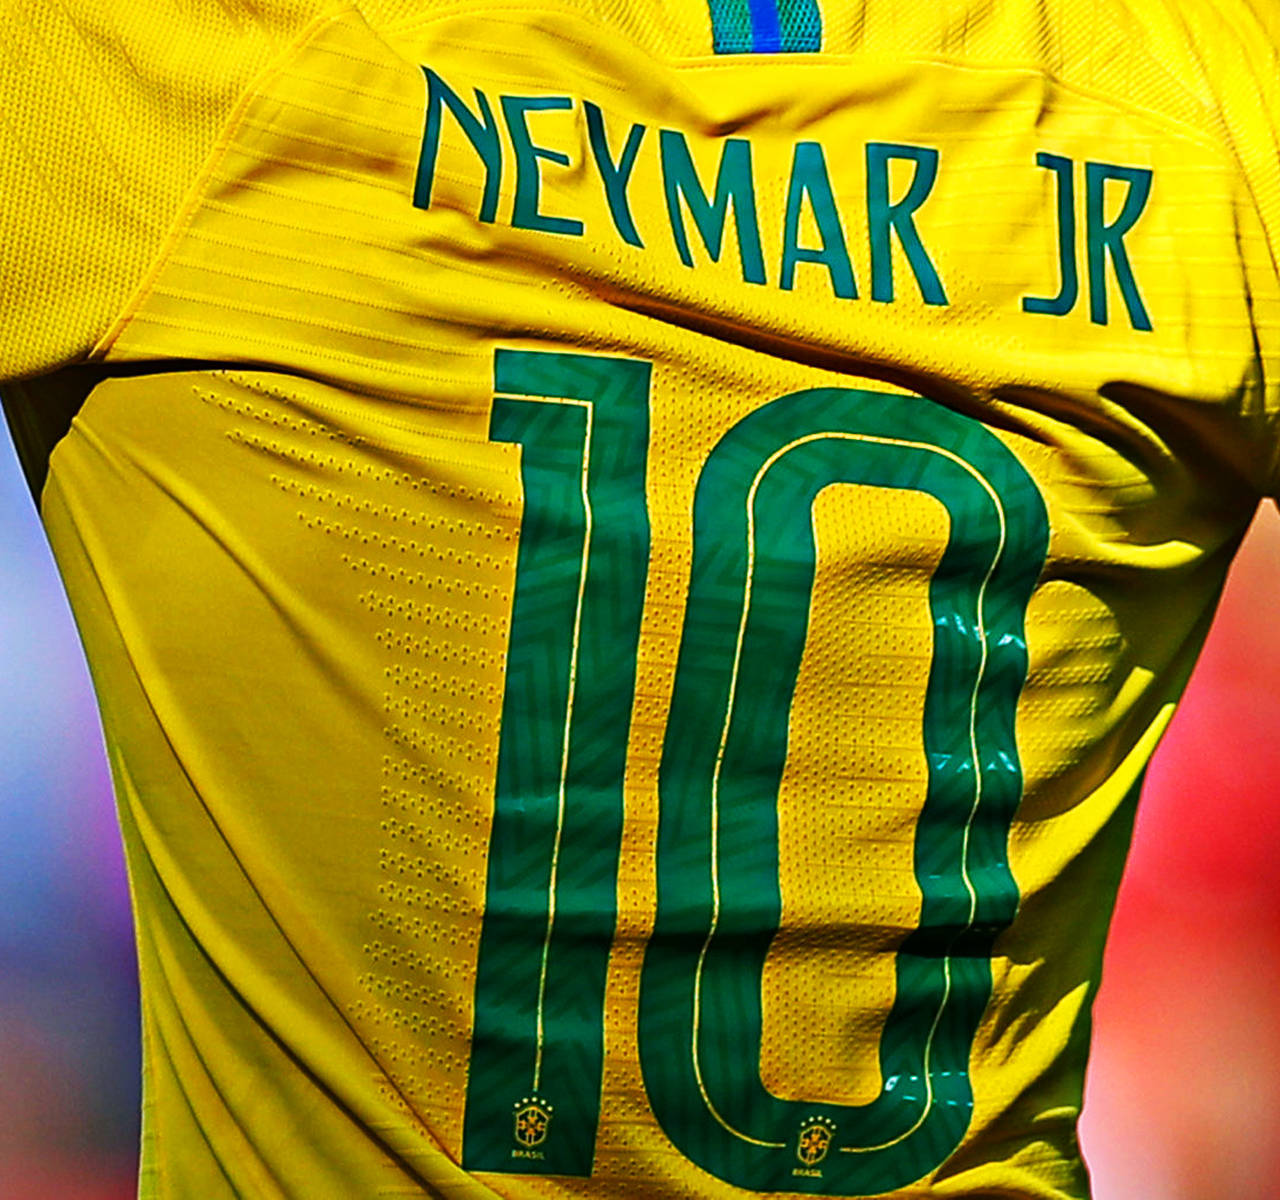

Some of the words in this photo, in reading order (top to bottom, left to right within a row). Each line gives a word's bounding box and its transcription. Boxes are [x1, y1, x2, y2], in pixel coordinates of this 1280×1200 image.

[412, 65, 950, 306] NEYMAR
[1022, 151, 1154, 332] JR
[462, 348, 1051, 1196] 10
